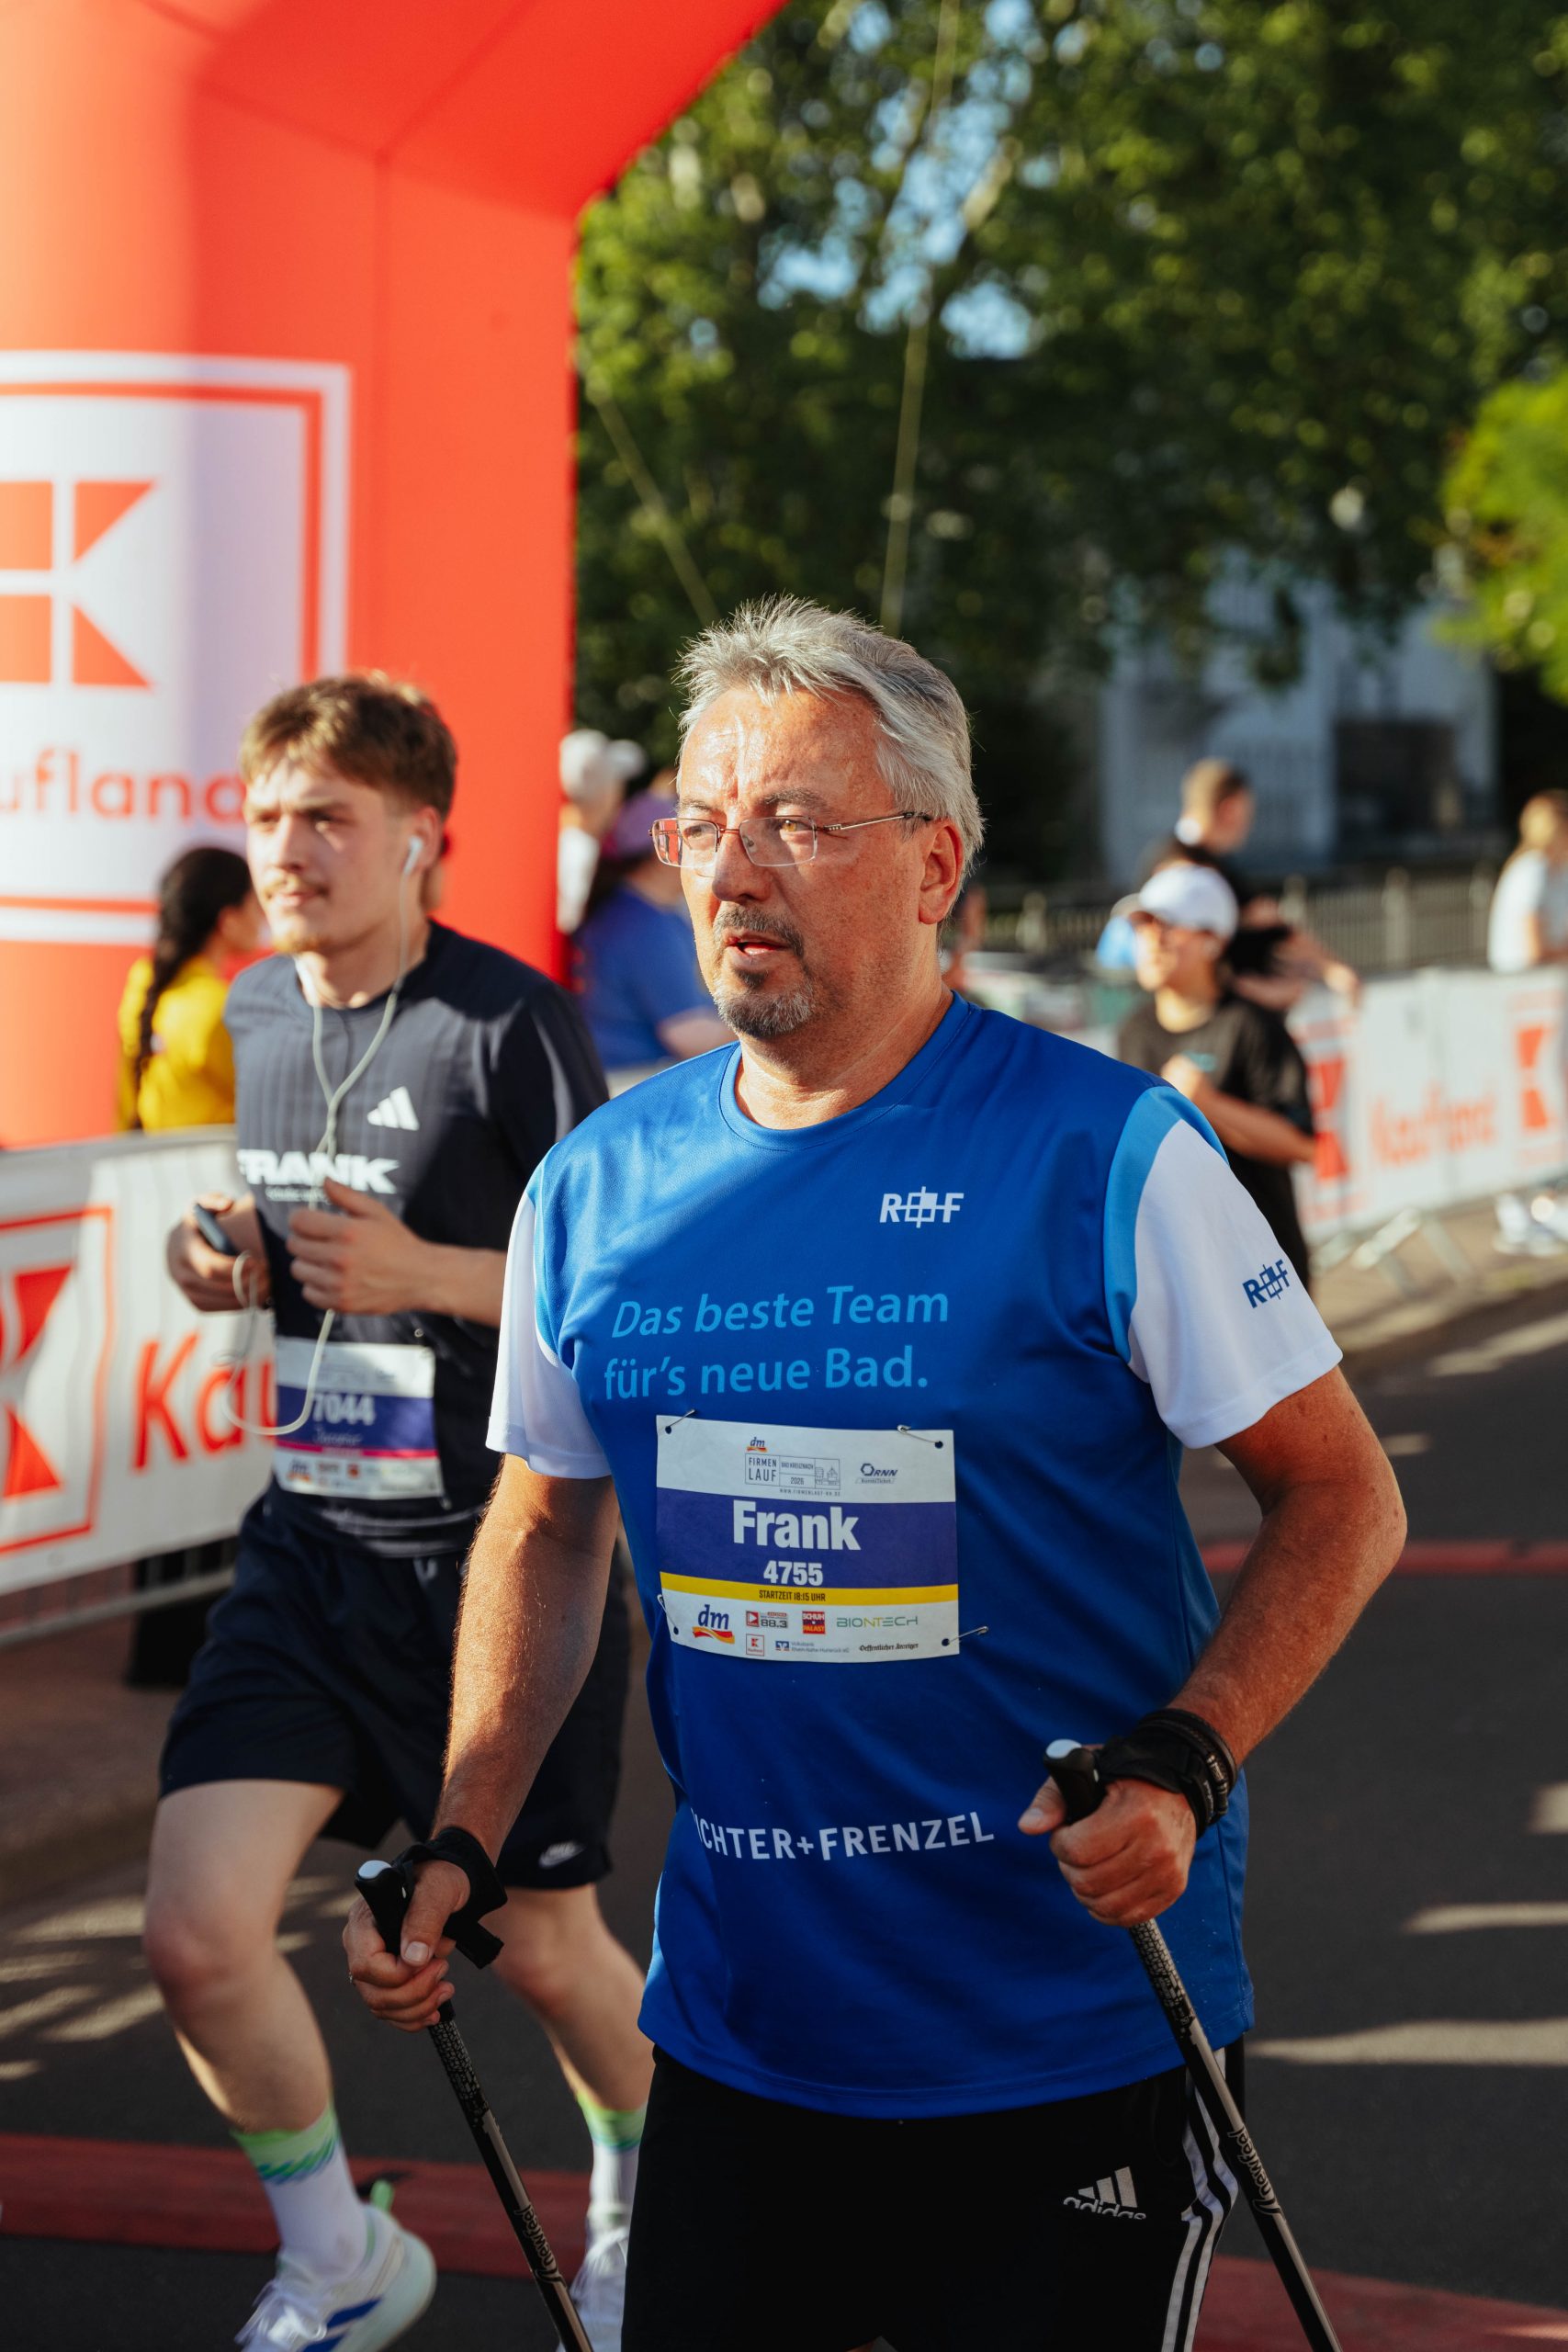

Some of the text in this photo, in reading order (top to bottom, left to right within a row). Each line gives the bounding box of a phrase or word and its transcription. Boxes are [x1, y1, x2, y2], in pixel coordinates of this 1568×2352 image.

[611, 1284, 949, 1339] Das beste Team
[604, 1344, 929, 1400] für's neue Bad.
[312, 1393, 376, 1426] 7044
[750, 1436, 765, 1448] dm
[749, 1456, 777, 1468] FIRMEN
[749, 1468, 777, 1483] LAUF
[733, 1499, 862, 1551] Frank
[763, 1560, 824, 1587] 4755
[759, 1589, 826, 1602] STARTZEIT 18:15 UHR
[697, 1603, 730, 1631] dm
[761, 1618, 788, 1629] 88.3
[836, 1616, 919, 1629] BIONTECH
[691, 1806, 995, 1860] ICHTER+FRENZEL
